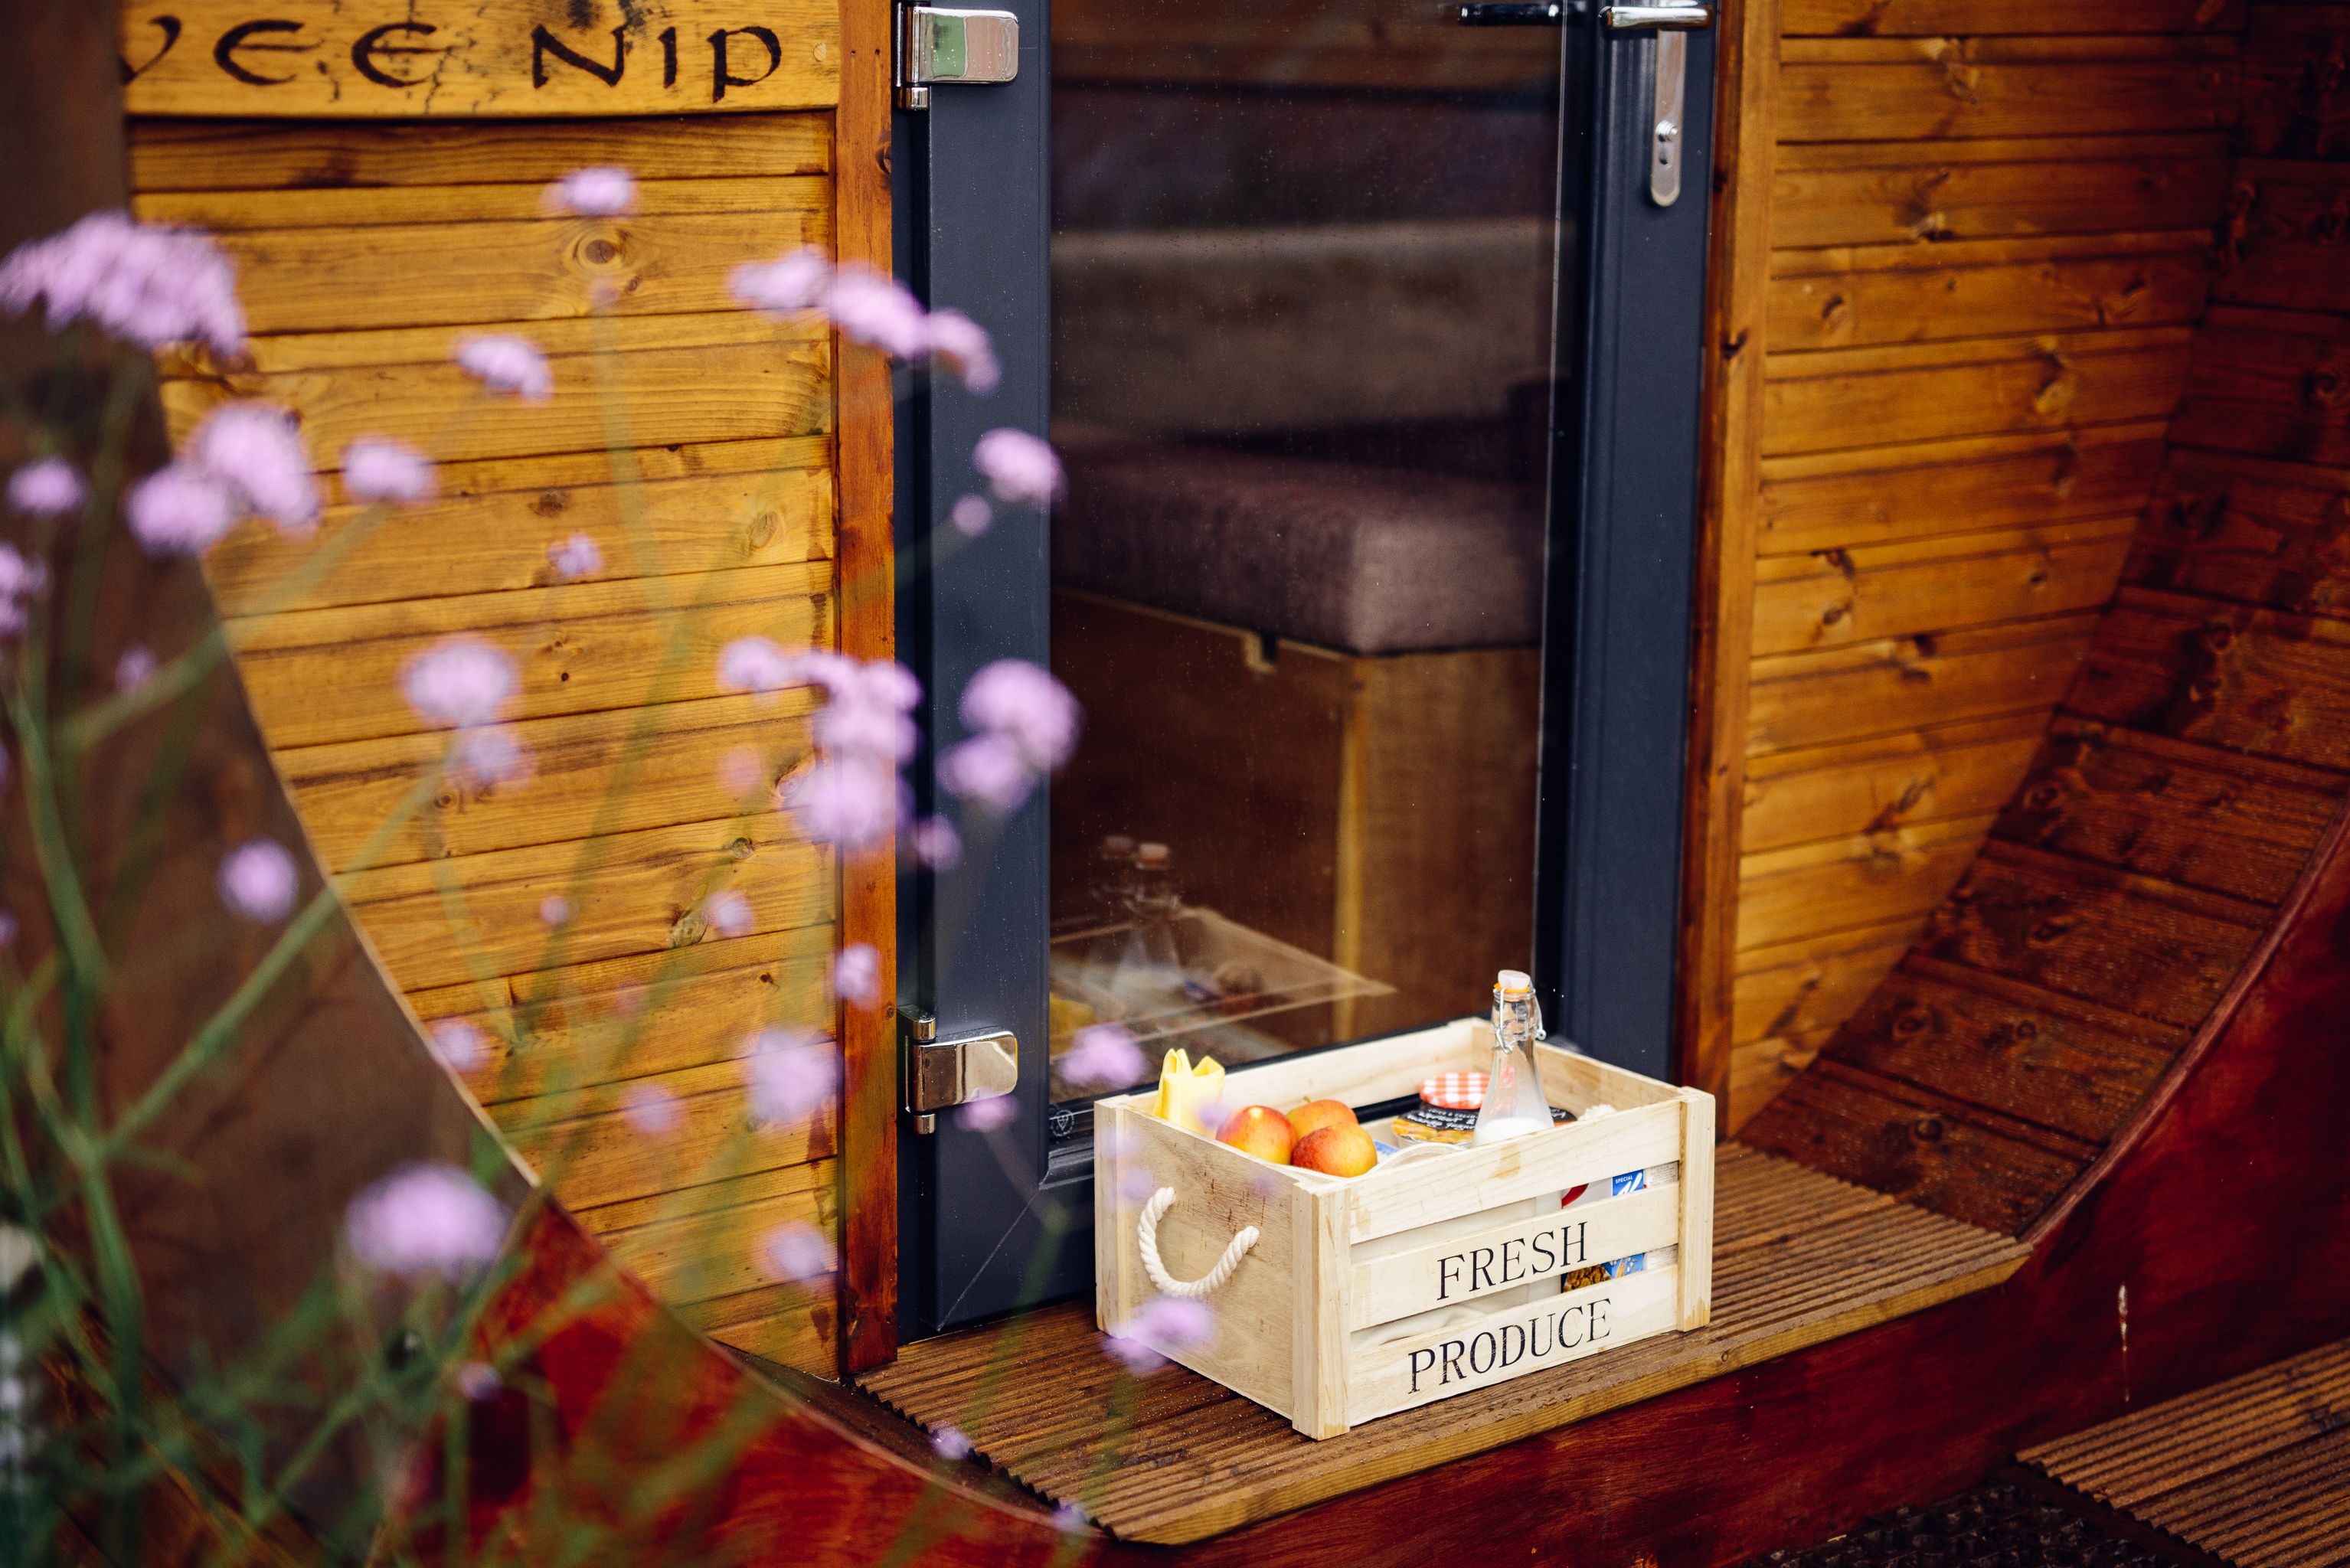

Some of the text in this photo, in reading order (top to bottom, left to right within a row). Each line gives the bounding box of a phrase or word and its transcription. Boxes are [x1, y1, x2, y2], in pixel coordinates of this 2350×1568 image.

[1615, 1174, 1633, 1184] SPECIAL
[1437, 1221, 1587, 1300] FRESH
[1408, 1298, 1612, 1393] PRODUCE
